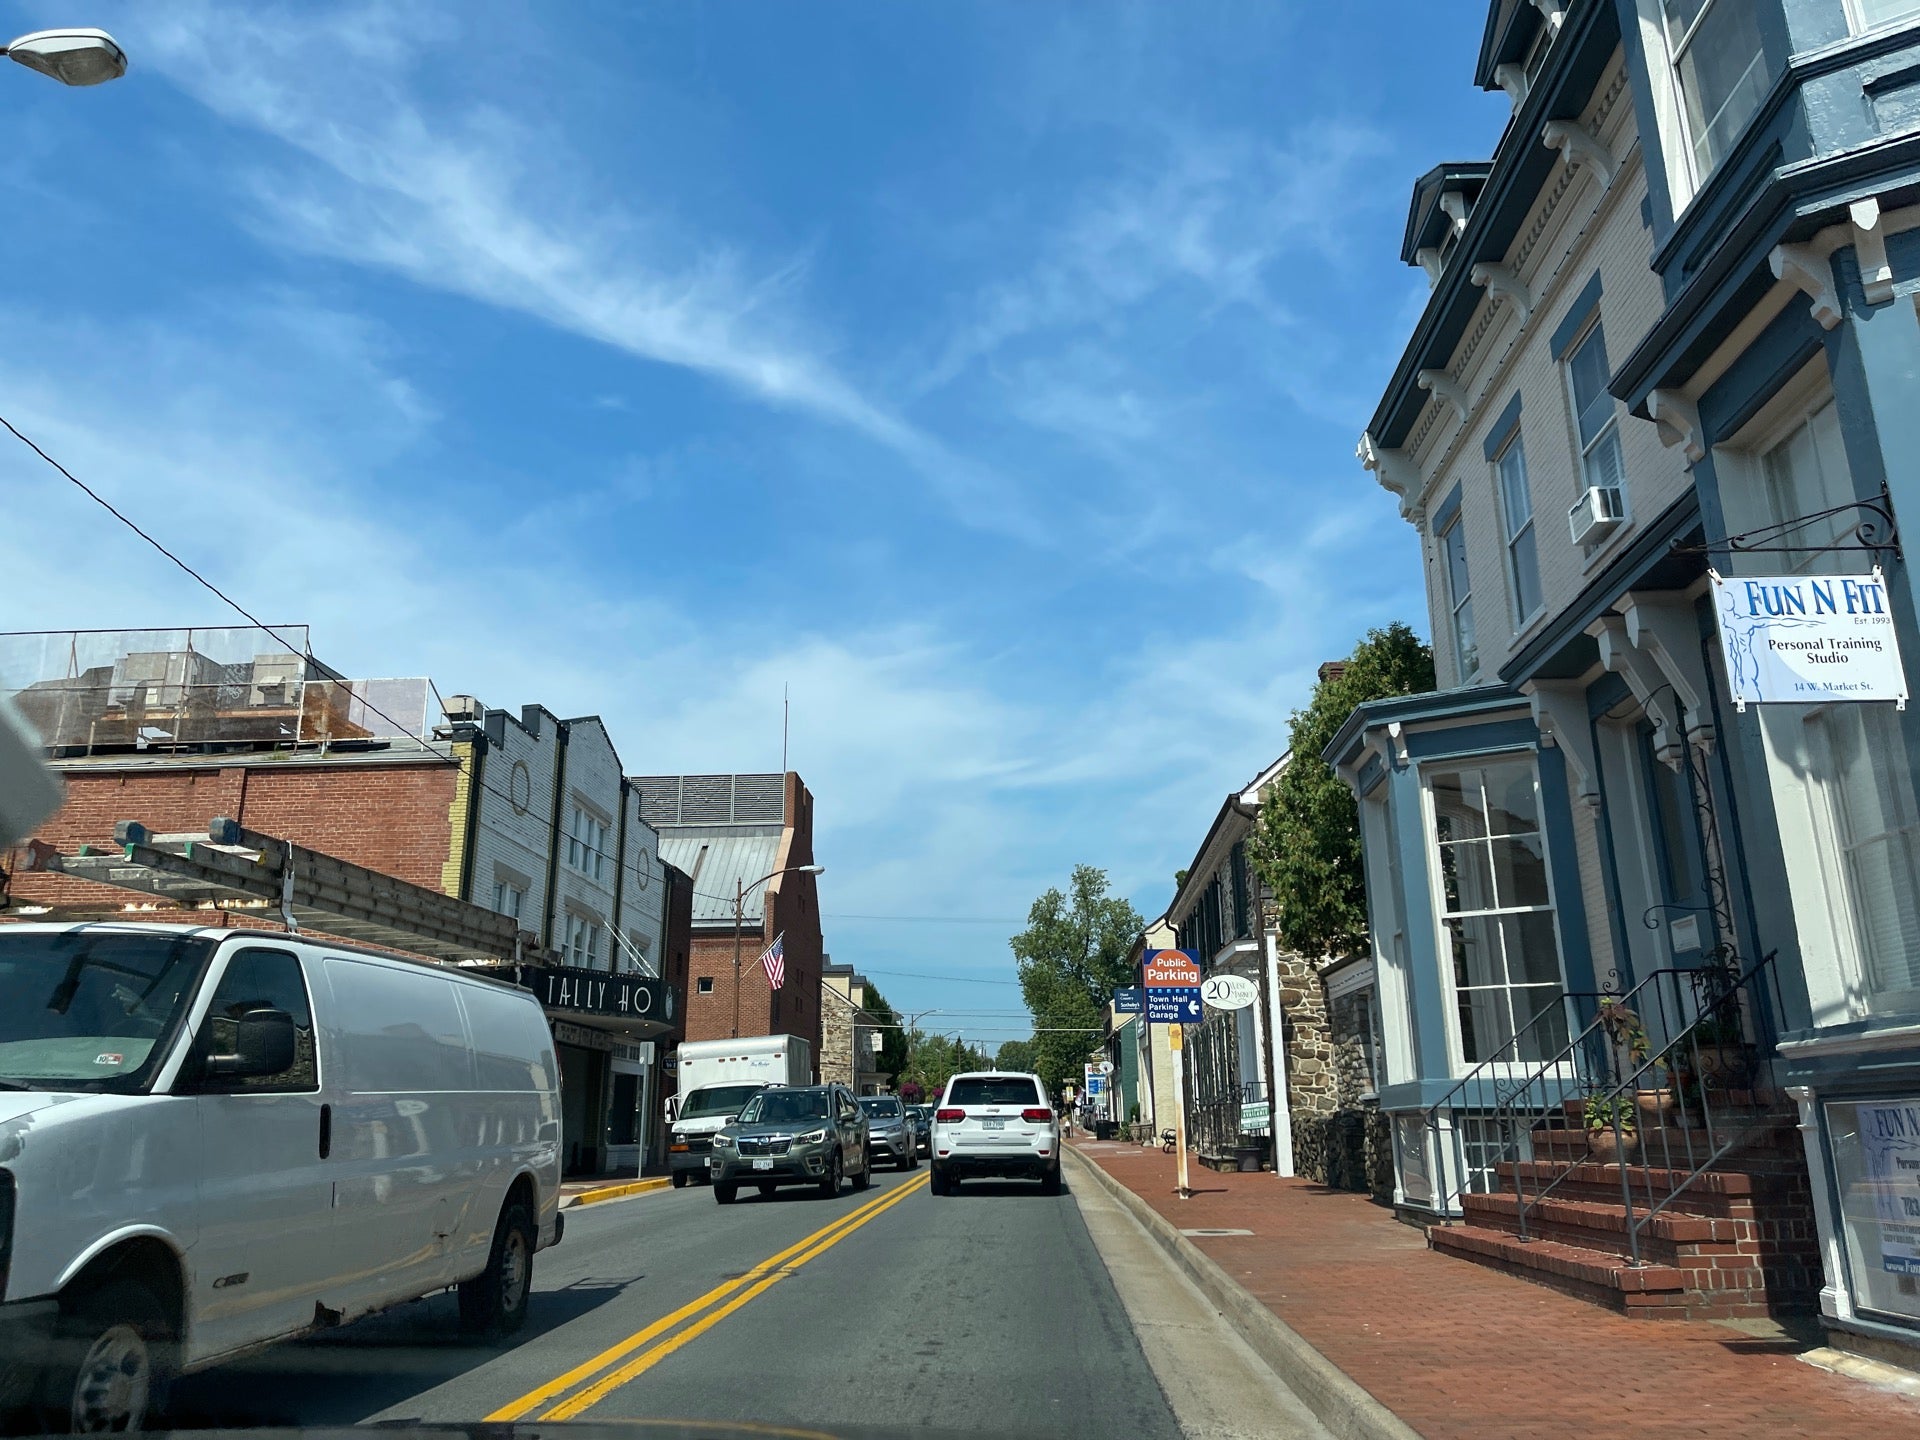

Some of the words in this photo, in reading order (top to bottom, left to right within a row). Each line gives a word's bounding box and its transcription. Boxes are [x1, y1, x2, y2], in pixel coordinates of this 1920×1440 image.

[1744, 581, 1806, 616] FUN
[1811, 579, 1837, 614] N
[1840, 579, 1886, 614] FIT
[1872, 617, 1891, 625] 1993
[1768, 638, 1824, 650] Personal
[1827, 637, 1882, 652] Training
[1807, 652, 1849, 664] Studio
[1795, 683, 1805, 691] 14
[1806, 683, 1820, 691] W.
[1823, 682, 1858, 691] Market
[1860, 682, 1874, 691] St.
[1157, 958, 1187, 967] Public
[1147, 969, 1197, 982] Parking
[548, 976, 606, 1009] TALLY
[618, 985, 652, 1013] HO
[1207, 980, 1230, 999] 20
[1149, 995, 1169, 1003] Town
[1172, 995, 1188, 1003] Hall
[1149, 1003, 1179, 1012] Parking
[1149, 1012, 1179, 1020] Garage
[1874, 1109, 1905, 1138] FUN
